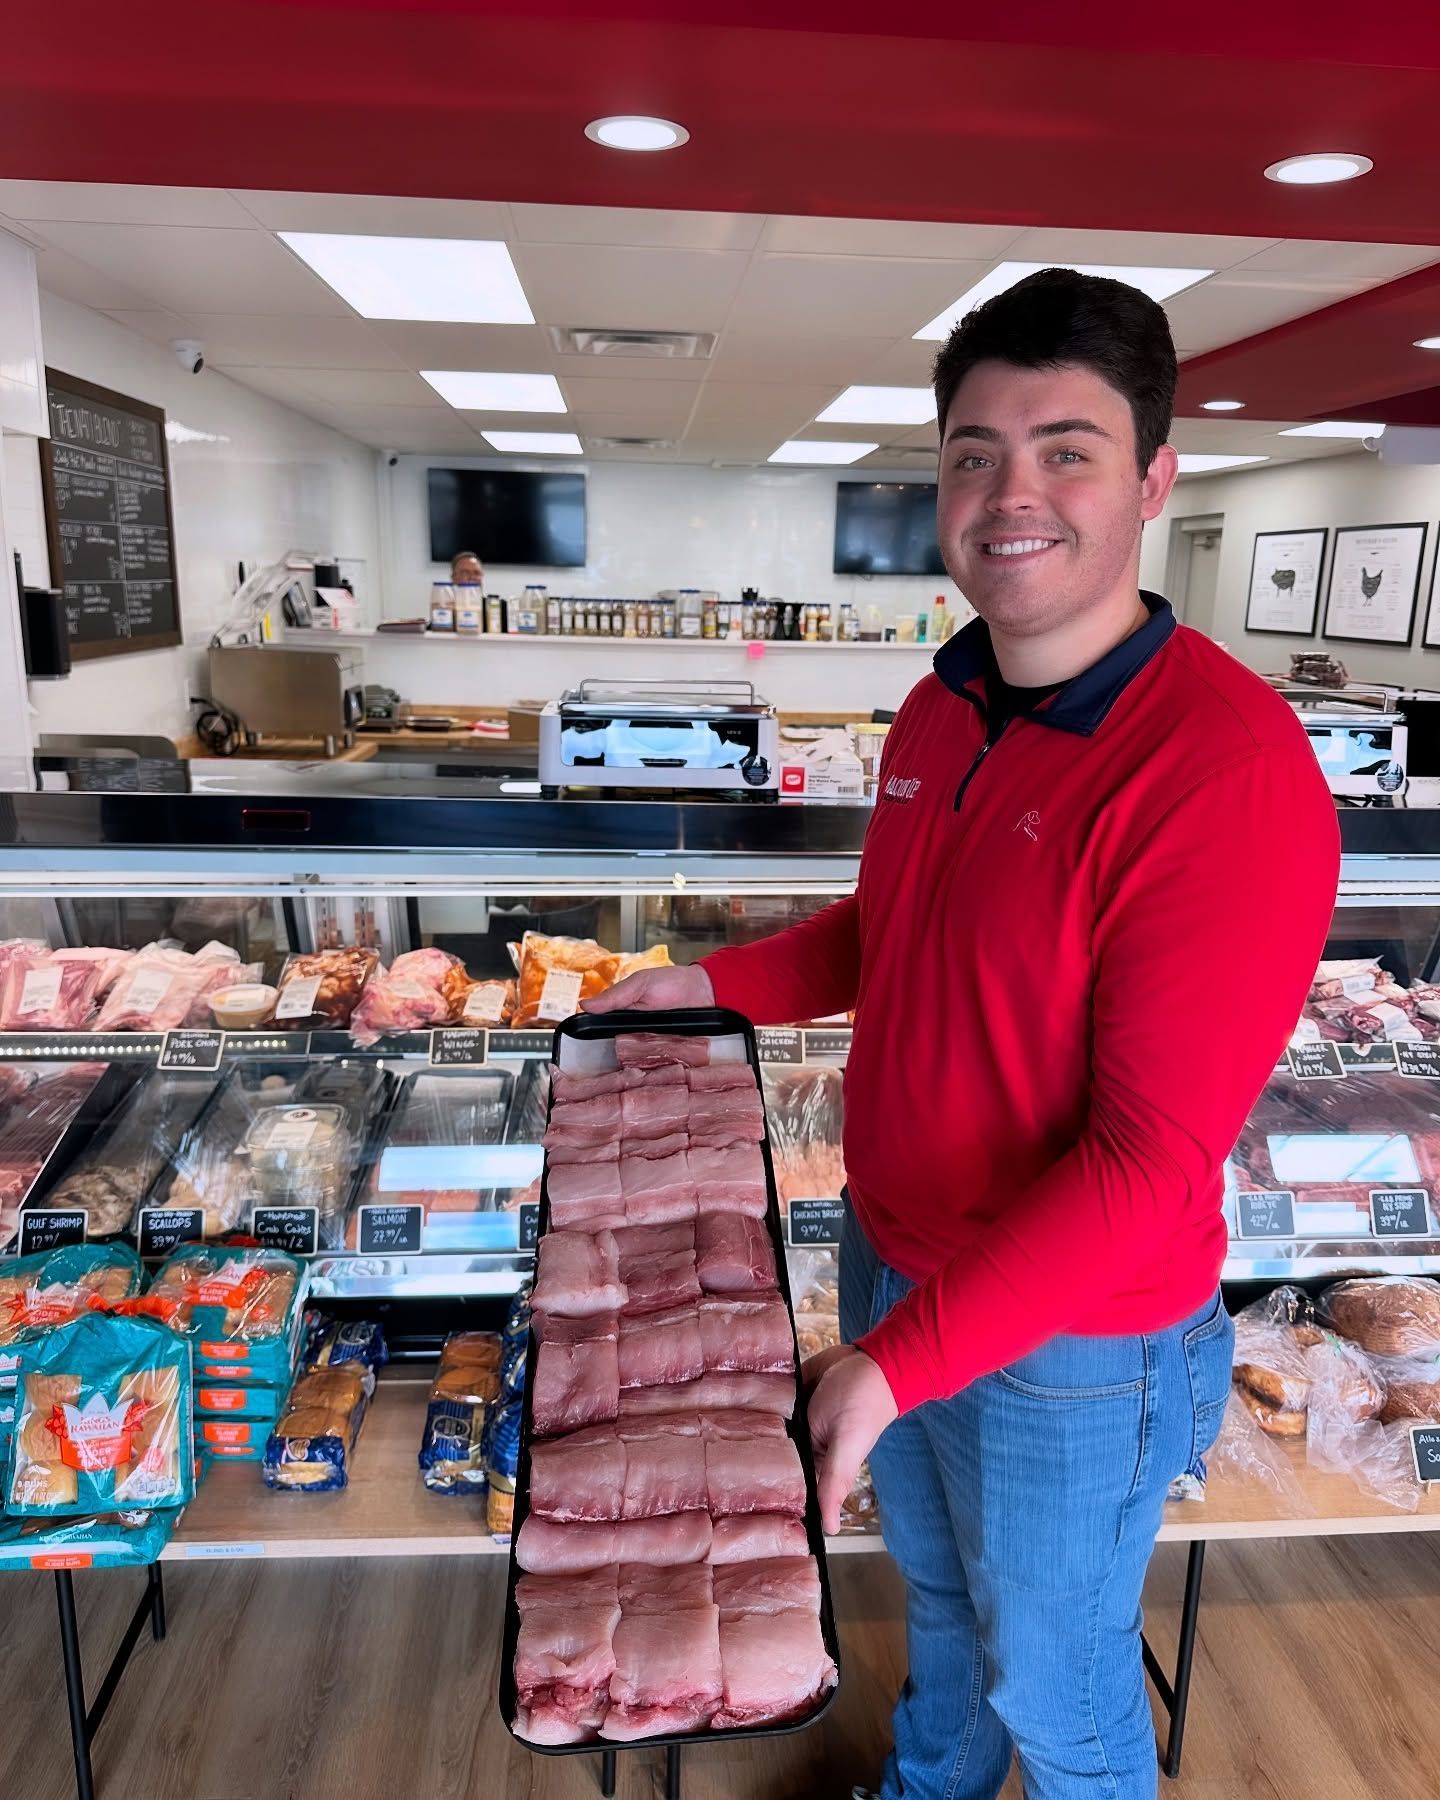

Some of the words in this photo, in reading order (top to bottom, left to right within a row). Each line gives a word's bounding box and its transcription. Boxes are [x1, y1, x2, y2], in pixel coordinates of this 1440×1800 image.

[27, 1217, 47, 1230] GULF
[49, 1217, 83, 1230] SHRIMP
[148, 1217, 192, 1230] SCALLOPS
[371, 1214, 407, 1226] SALMON
